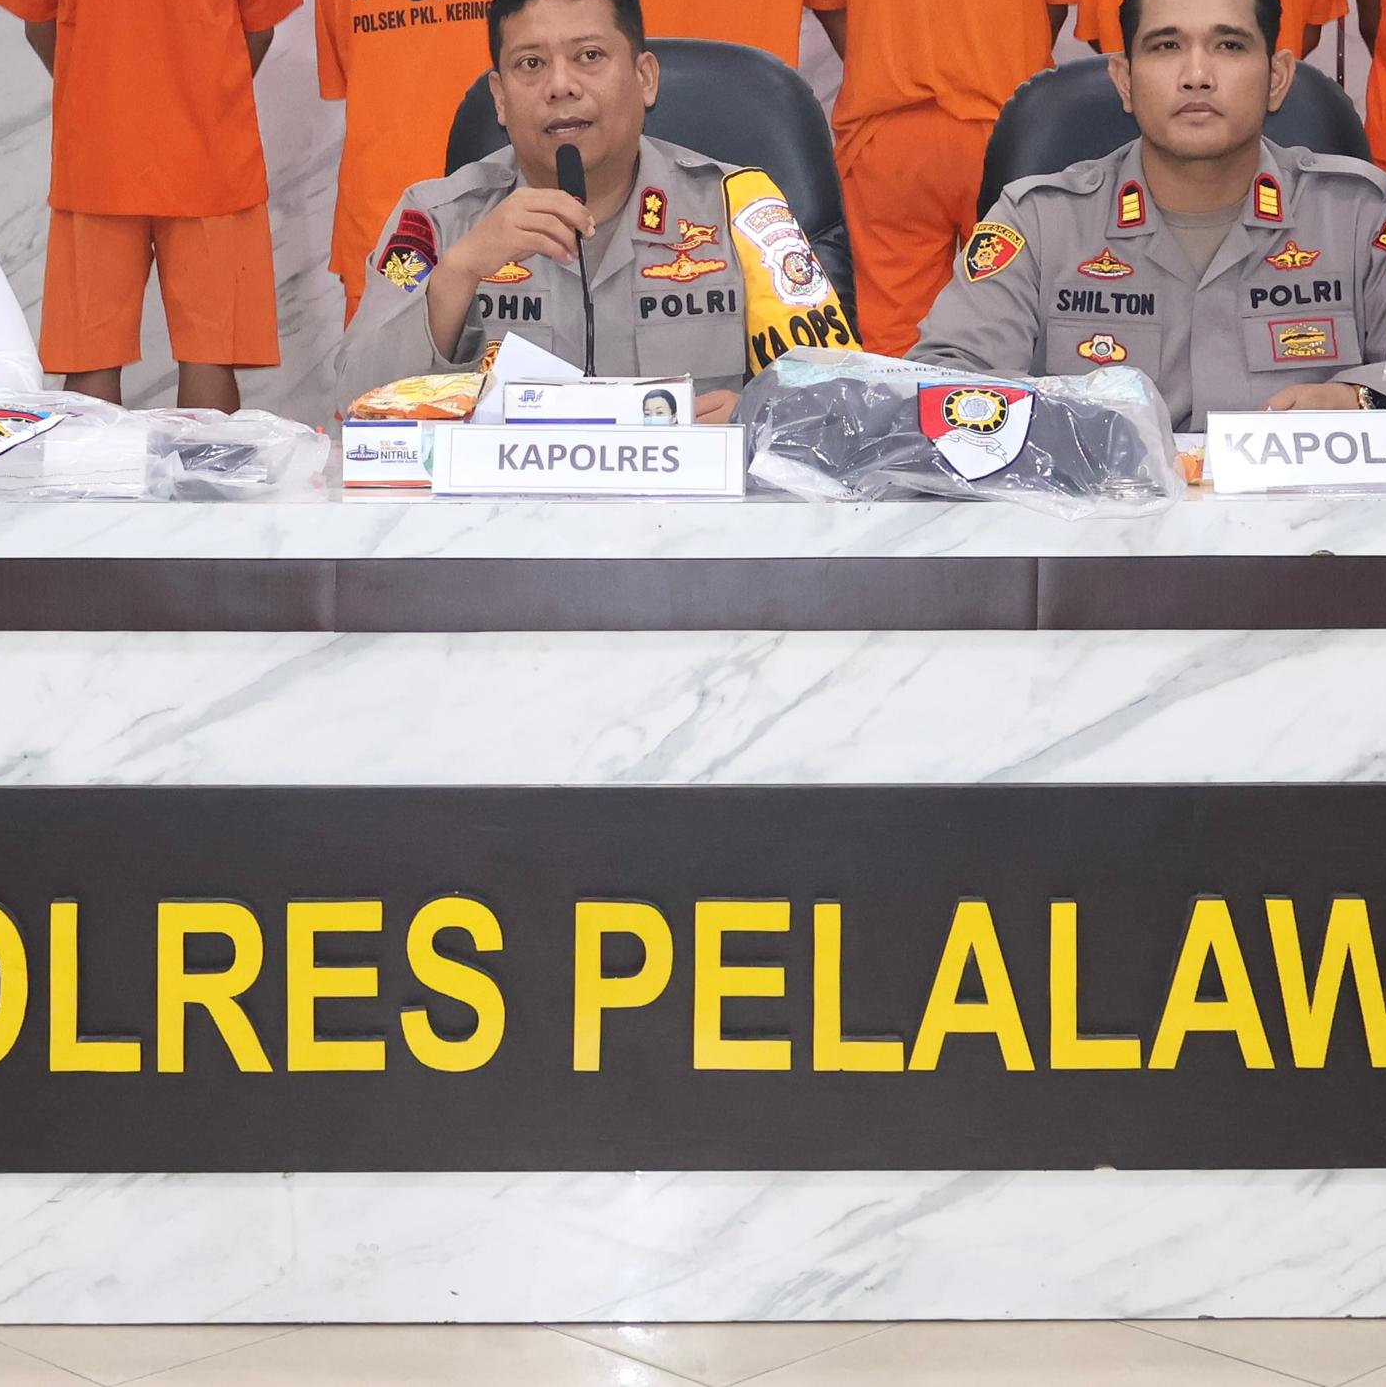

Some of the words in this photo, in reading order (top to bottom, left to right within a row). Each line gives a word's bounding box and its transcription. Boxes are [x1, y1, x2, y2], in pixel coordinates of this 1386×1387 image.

[353, 9, 406, 33] POLSEK
[410, 5, 443, 25] PKL.
[640, 290, 737, 319] POLRI
[1056, 287, 1155, 316] SHILTON
[1250, 281, 1342, 309] POLRI
[752, 326, 789, 368] KA
[498, 442, 680, 474] KAPOLRES
